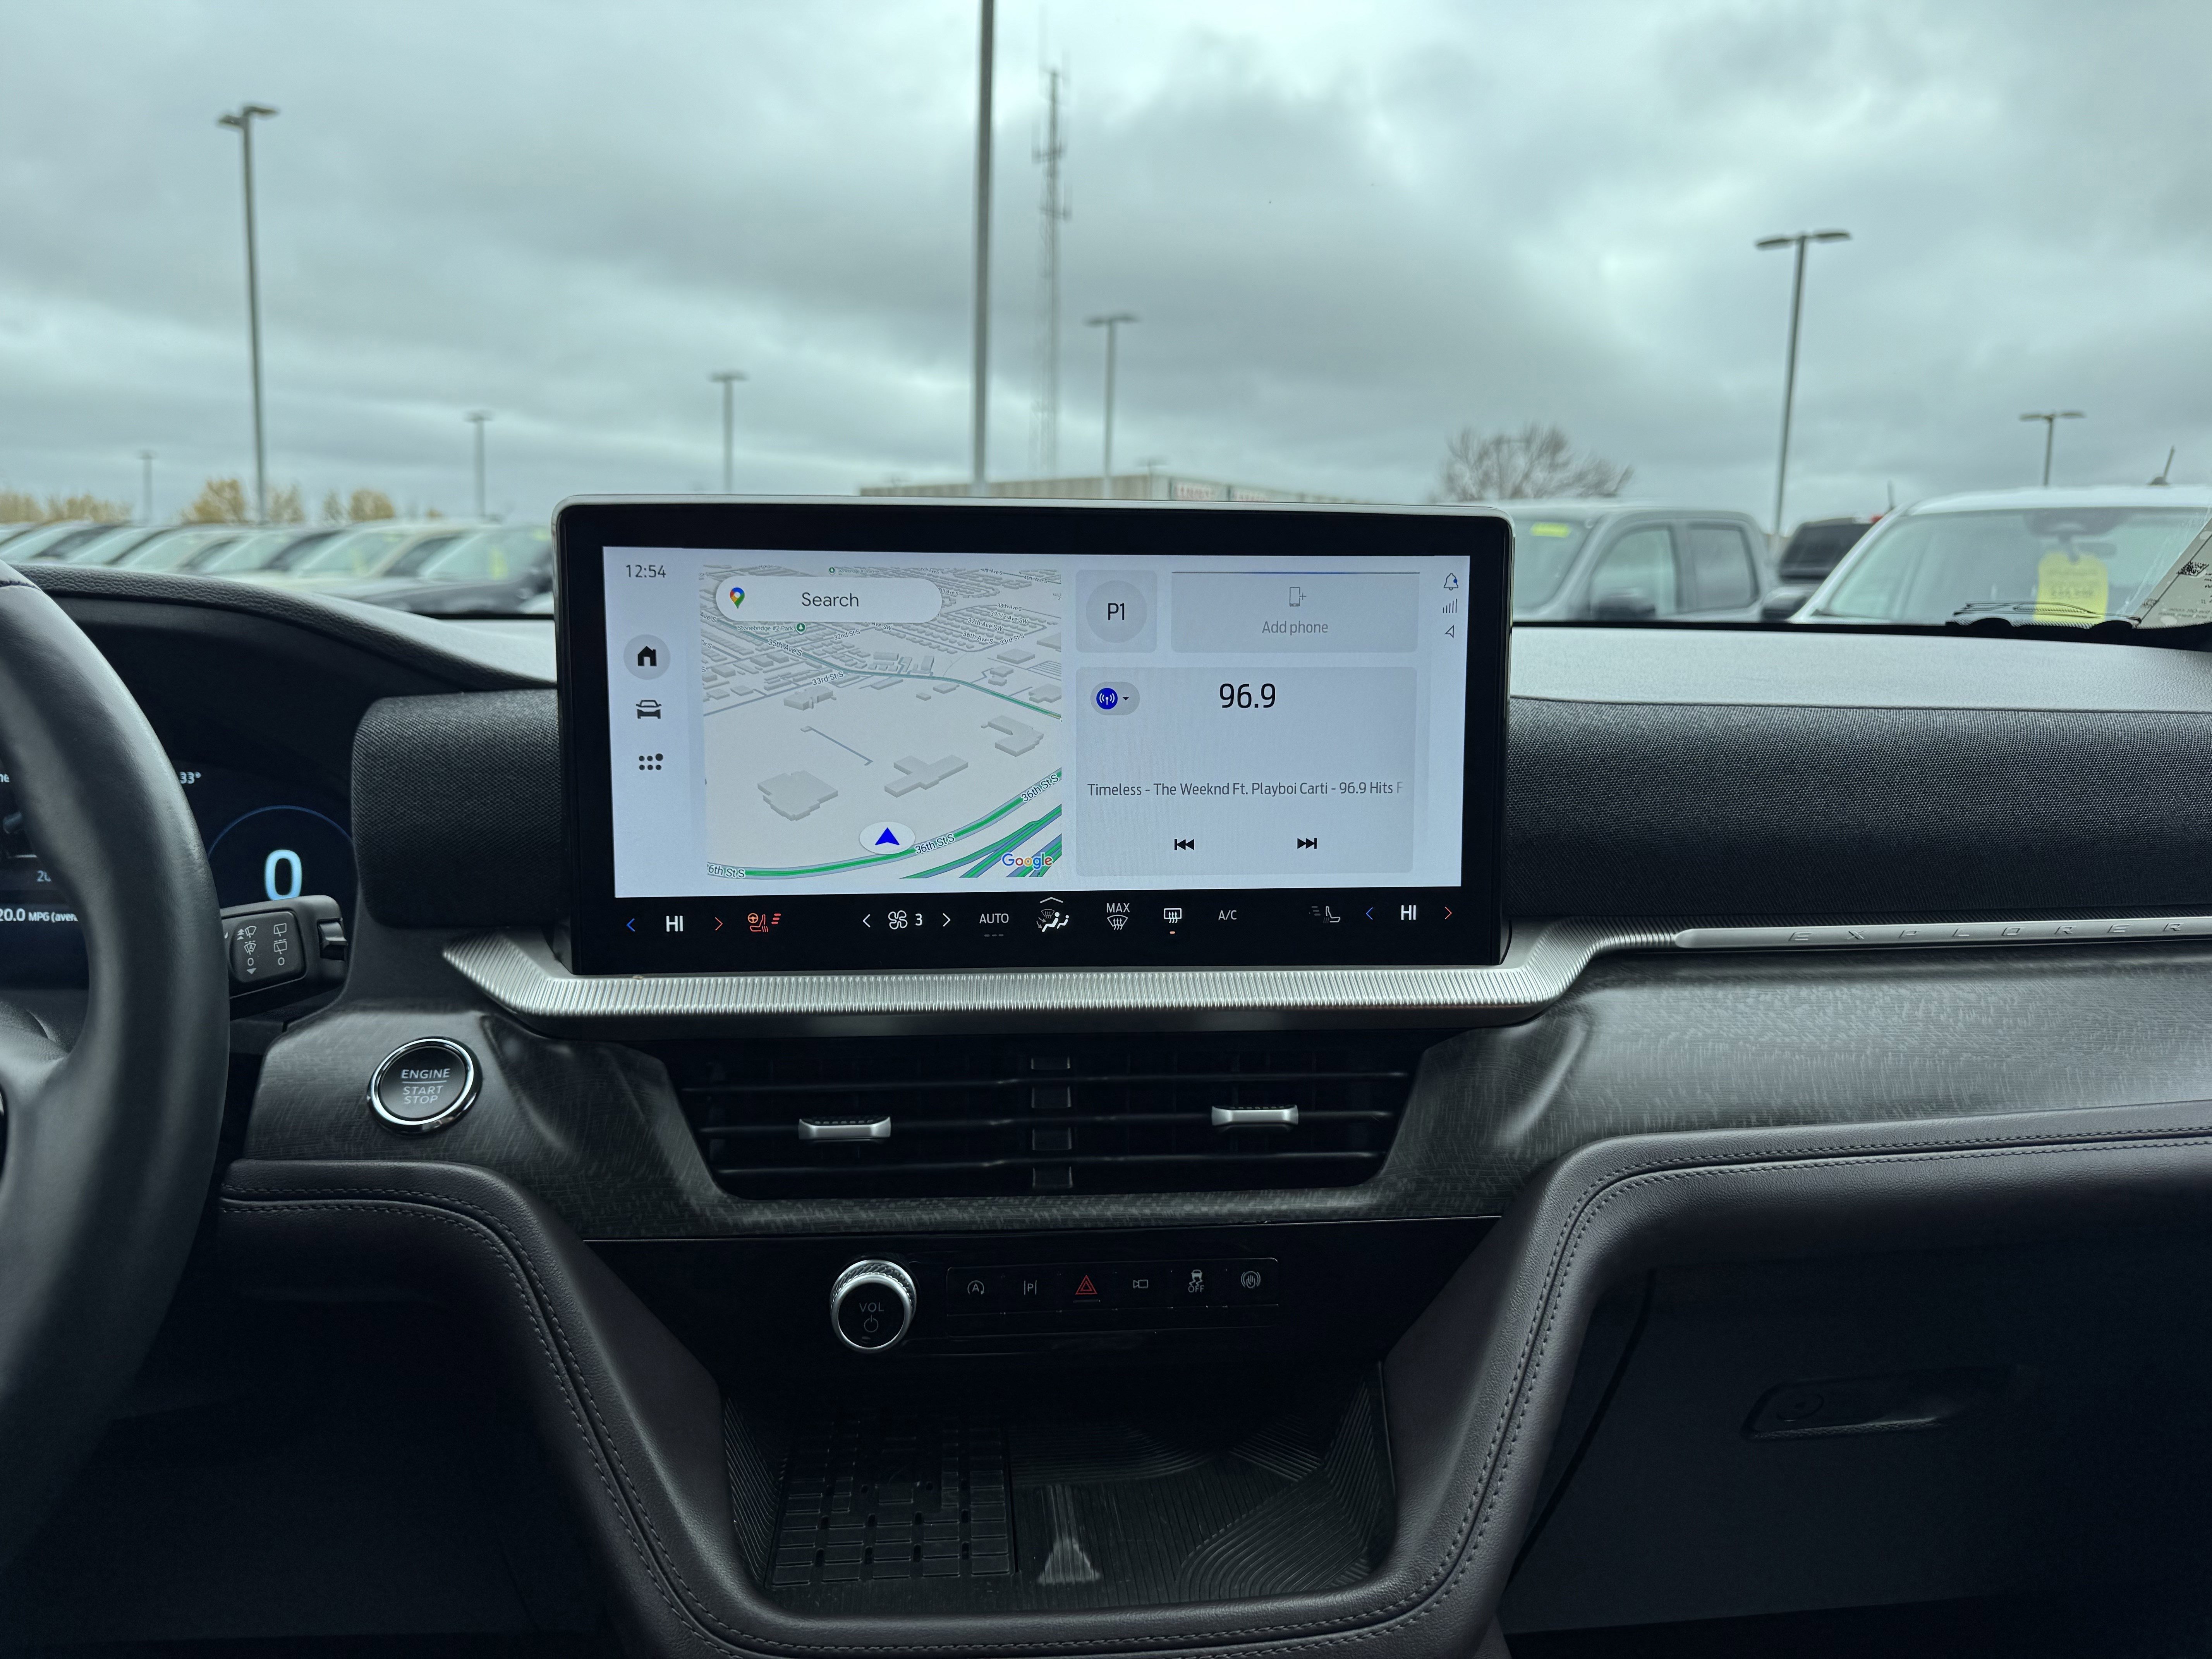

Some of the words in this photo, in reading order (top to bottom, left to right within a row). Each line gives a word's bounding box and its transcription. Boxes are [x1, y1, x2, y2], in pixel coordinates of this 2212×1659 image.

[626, 564, 666, 579] 12:54
[801, 592, 859, 607] Search
[1108, 603, 1125, 621] P1
[1262, 620, 1287, 634] Add
[1290, 620, 1328, 636] phone
[834, 632, 848, 640] 32nd
[1000, 637, 1013, 646] 33rd
[768, 639, 783, 648] 35th
[784, 645, 796, 653] Ave
[812, 676, 829, 685] 33rd
[1219, 683, 1276, 709] 96.9
[1021, 785, 1041, 802] 36th
[1041, 778, 1052, 789] St
[1051, 774, 1058, 783] S
[1087, 783, 1142, 796] Timeless
[1153, 782, 1177, 796] The
[1180, 782, 1230, 795] Weeknd
[1233, 782, 1249, 795] Ft.
[1252, 782, 1297, 797] Playboi
[1300, 782, 1328, 795] Carti
[1339, 781, 1367, 794] 96.9
[1370, 781, 1393, 794] Hits
[915, 842, 936, 854] 36th
[936, 837, 947, 847] St
[947, 834, 955, 843] S
[1002, 852, 1053, 870] Google
[264, 849, 302, 901] 0
[707, 864, 723, 875] 6th
[726, 868, 735, 878] St
[738, 869, 745, 878] S
[1106, 902, 1130, 913] MAX
[1400, 904, 1417, 921] HI
[28, 912, 50, 922] MPG
[915, 913, 923, 926] 3
[979, 913, 1009, 924] AUTO
[1218, 910, 1237, 921] A/C
[666, 915, 684, 933] HI
[1788, 922, 2184, 942] EXPLORER
[401, 1068, 451, 1079] ENGINE
[402, 1085, 444, 1095] START
[404, 1095, 438, 1104] STOP
[1188, 1285, 1205, 1293] OFF
[859, 1302, 884, 1313] VOL
